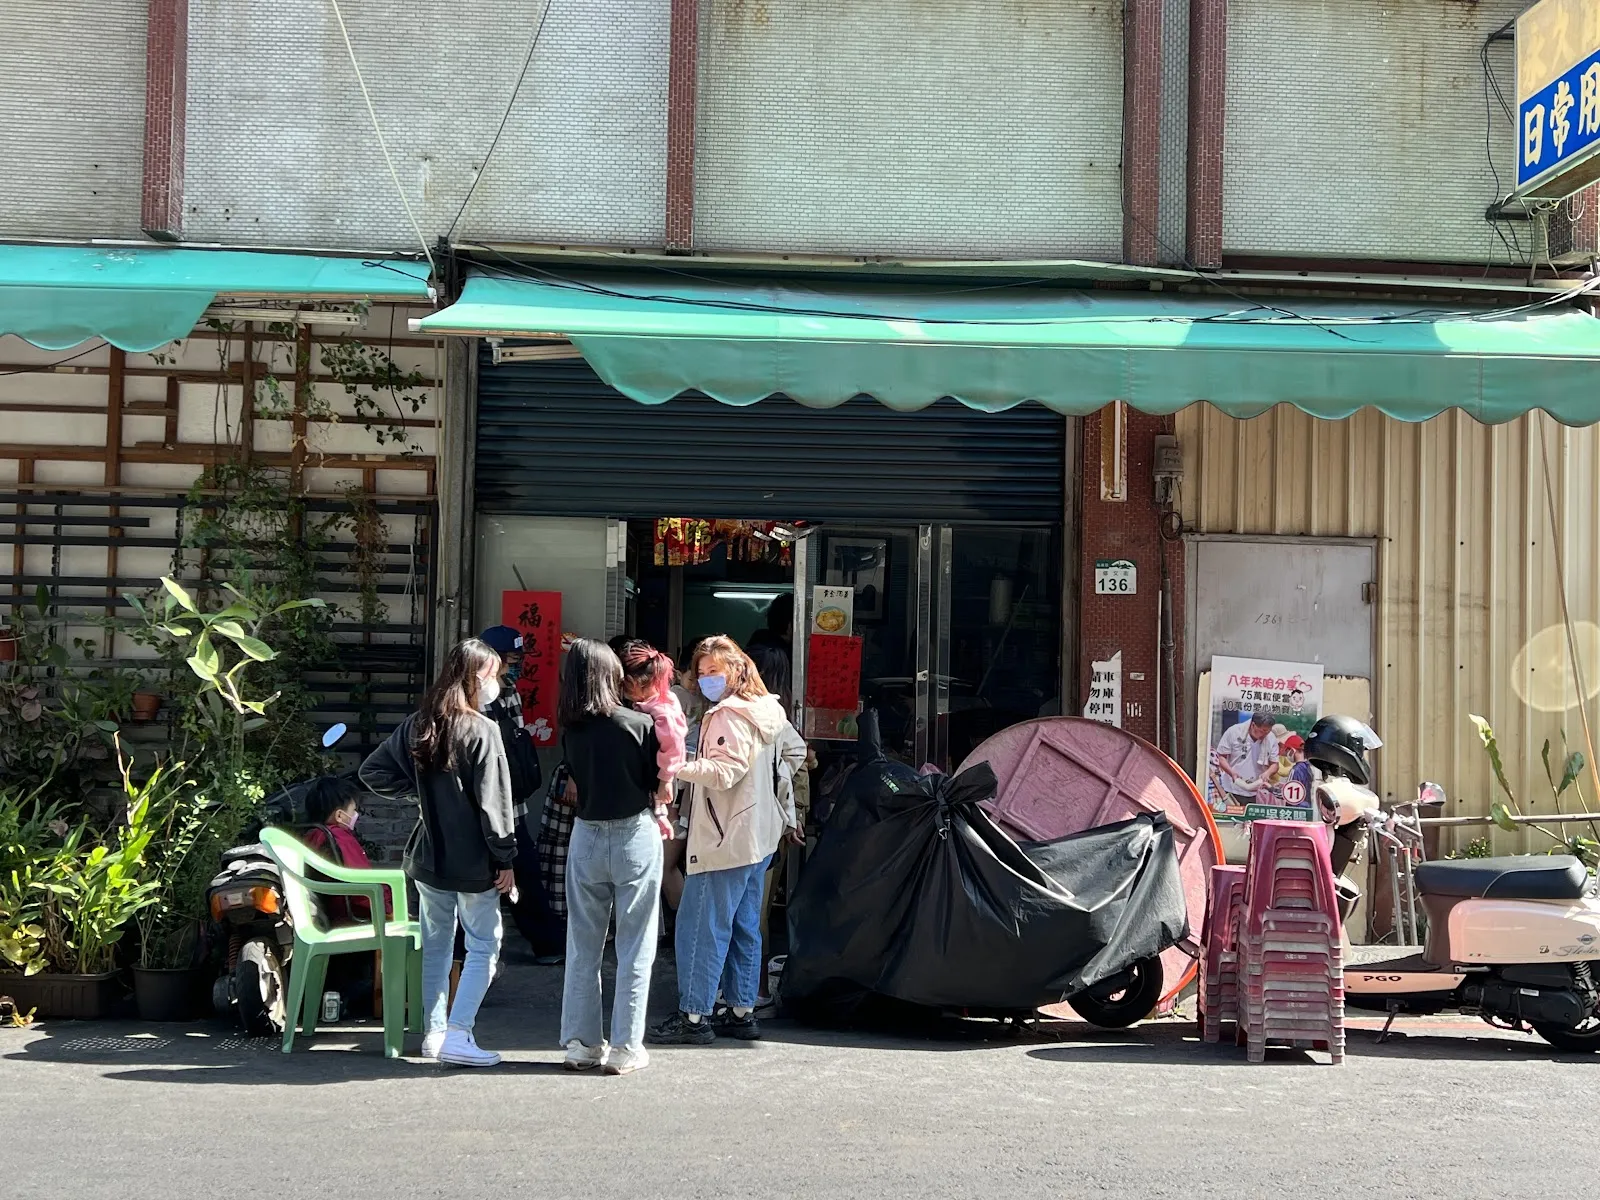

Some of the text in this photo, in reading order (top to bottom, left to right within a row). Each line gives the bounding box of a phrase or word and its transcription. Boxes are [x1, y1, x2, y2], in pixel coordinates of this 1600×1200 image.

[1098, 578, 1128, 591] 136
[1228, 674, 1298, 691] 八年來咱分享
[1286, 786, 1301, 799] 11
